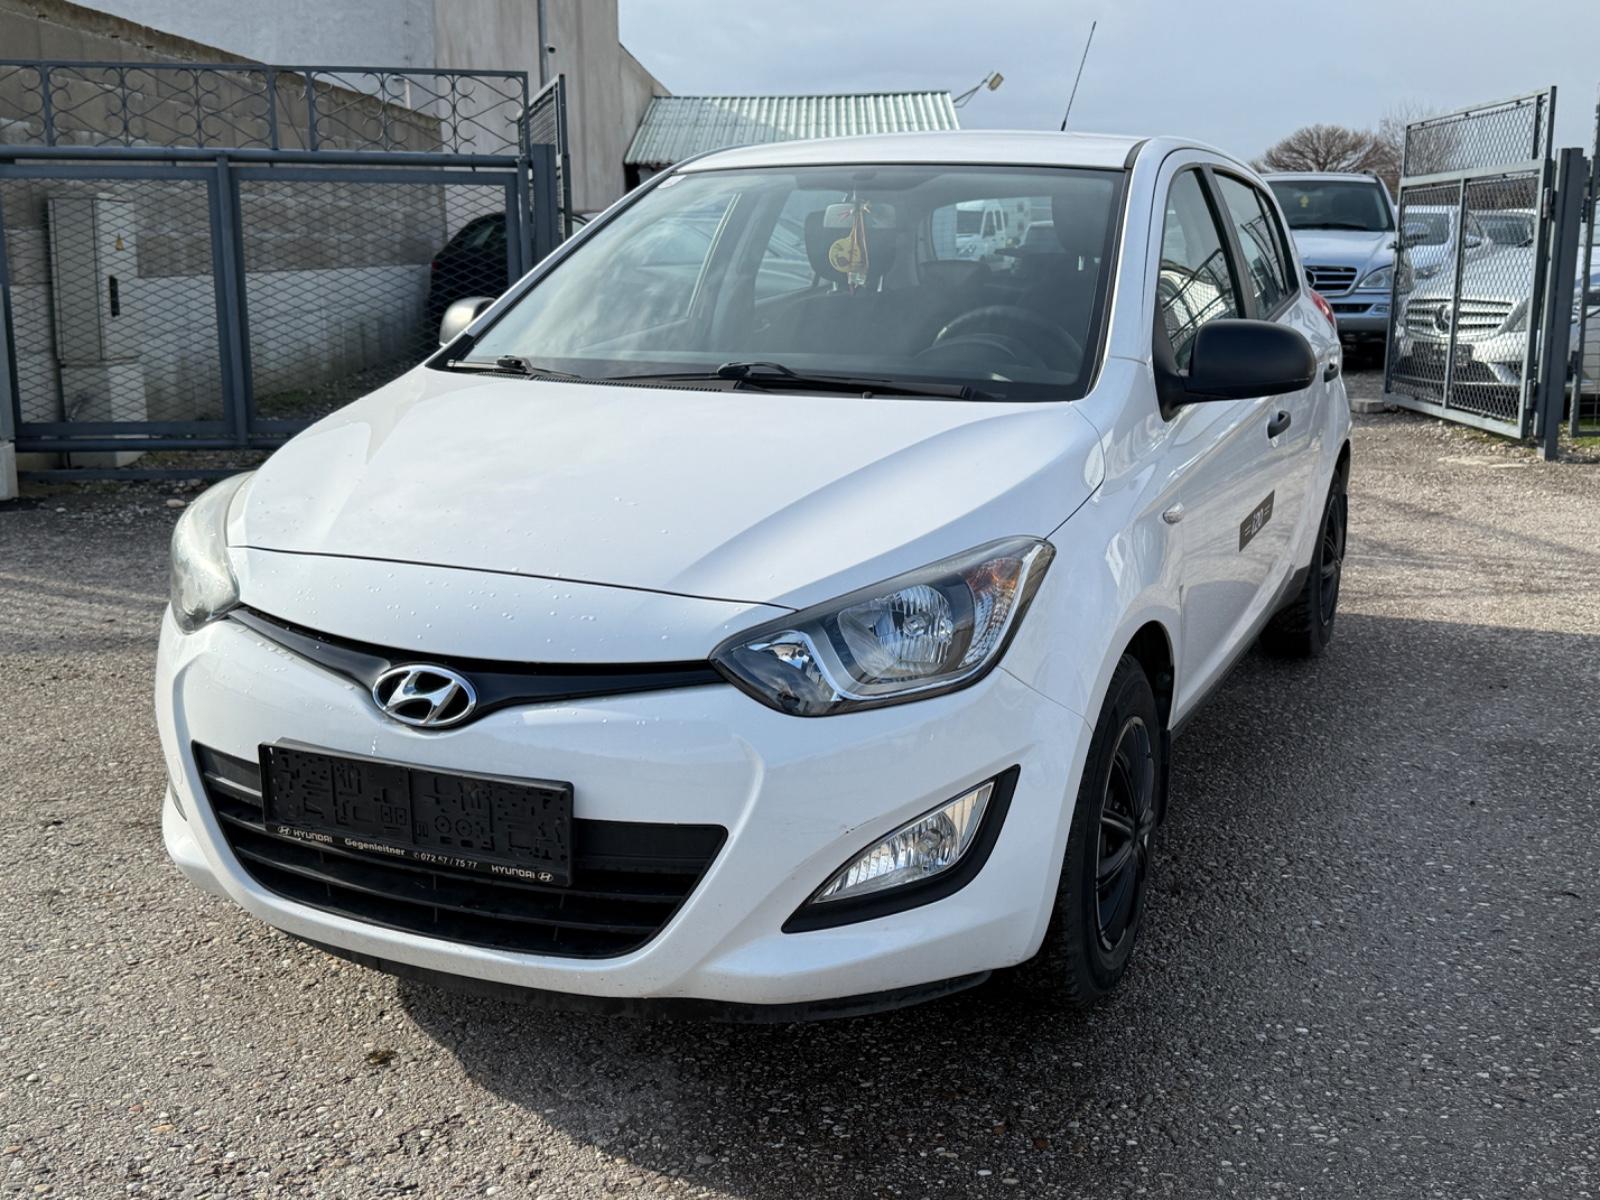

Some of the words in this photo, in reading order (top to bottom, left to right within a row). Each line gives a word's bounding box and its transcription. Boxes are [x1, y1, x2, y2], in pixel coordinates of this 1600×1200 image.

[293, 829, 333, 844] HYUNDAI
[344, 838, 406, 856] Gegenleitner
[491, 864, 536, 879] HYUNDAI
